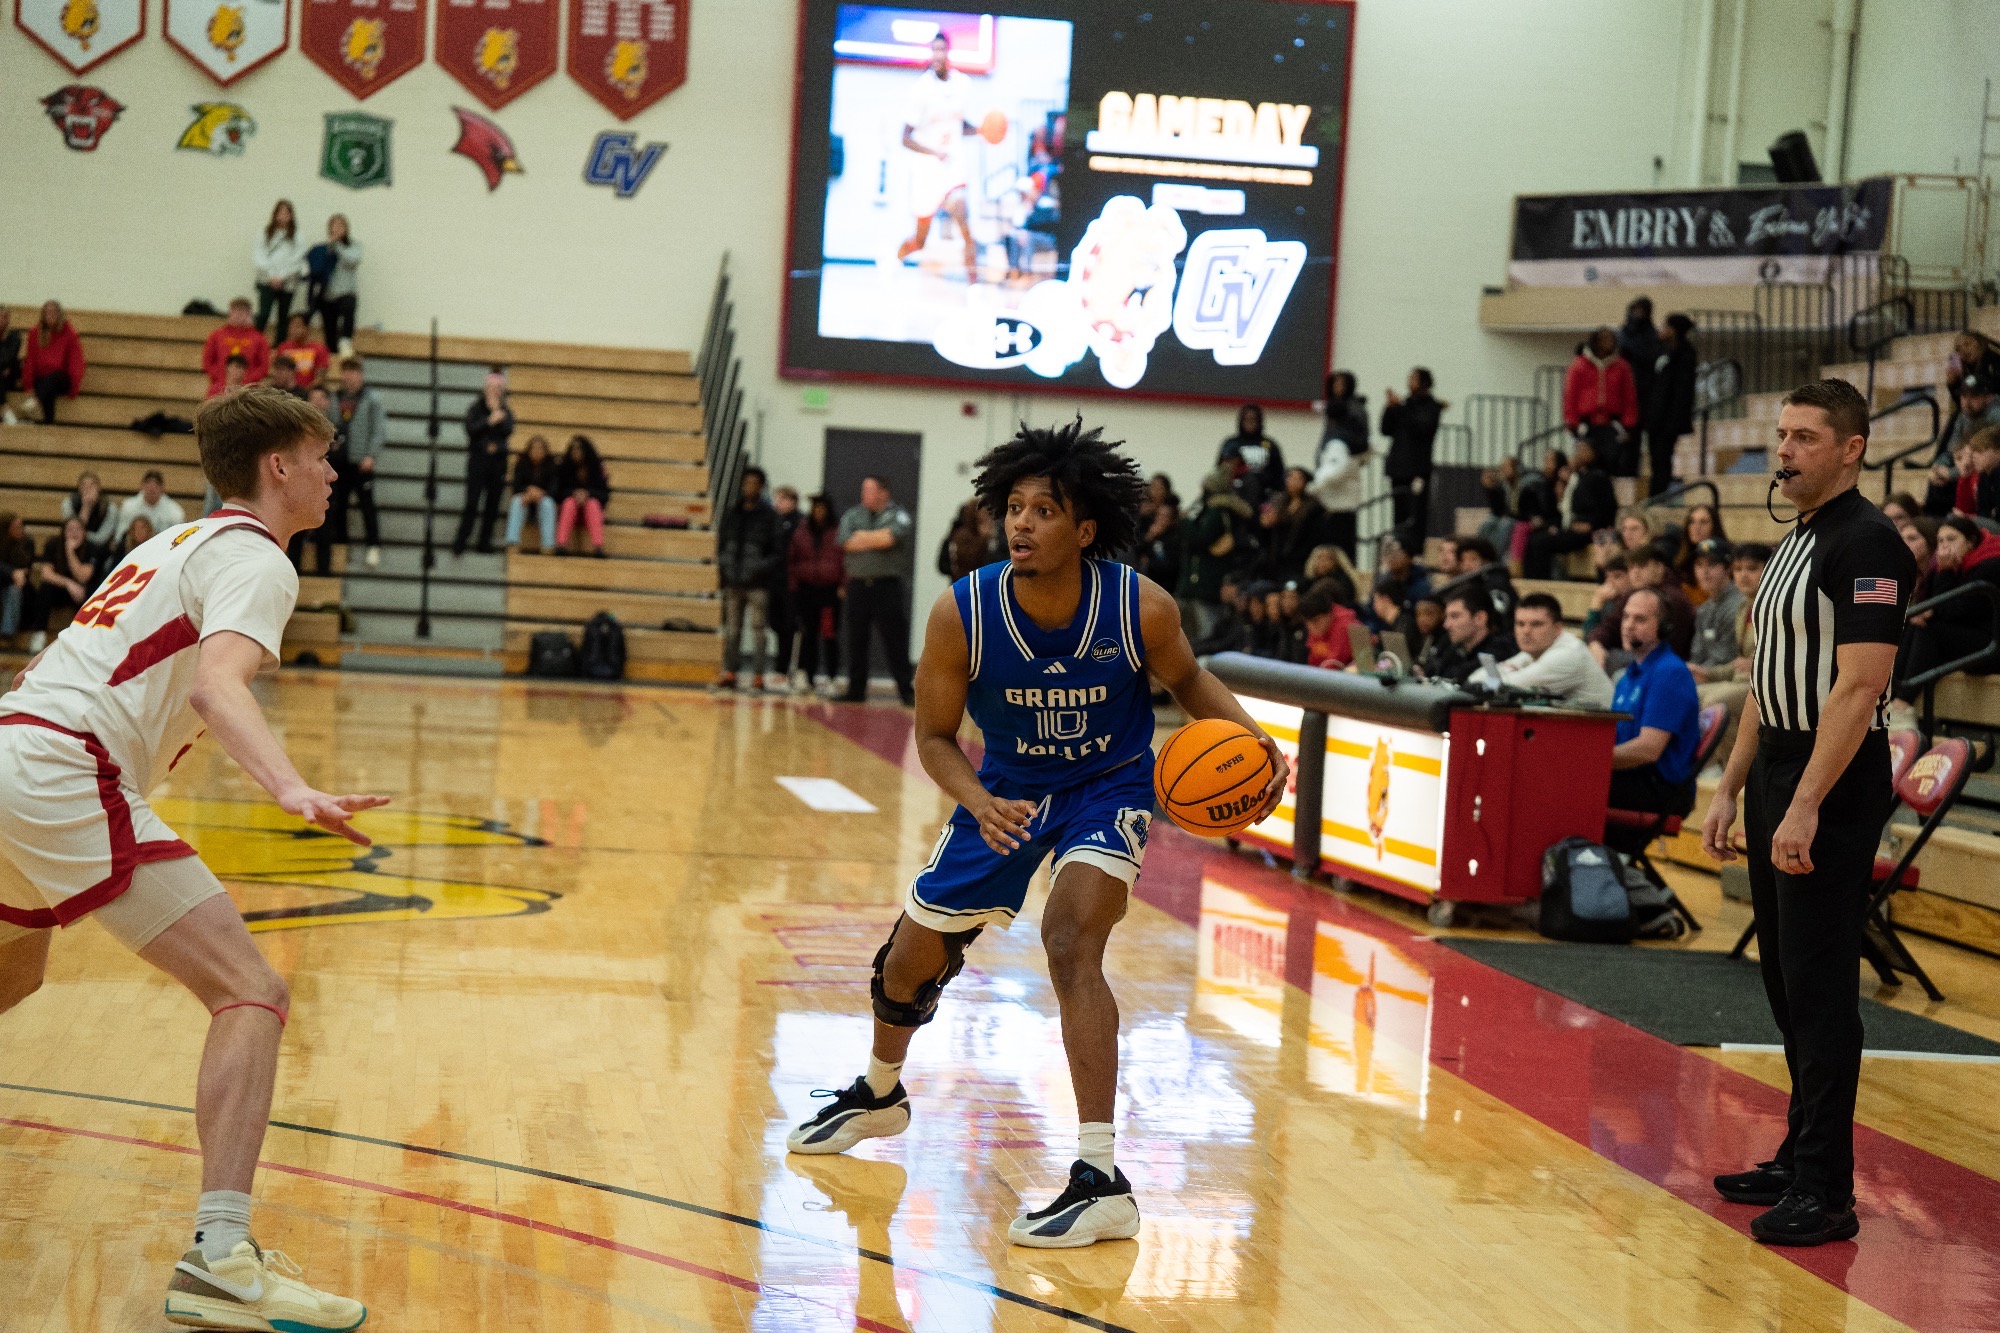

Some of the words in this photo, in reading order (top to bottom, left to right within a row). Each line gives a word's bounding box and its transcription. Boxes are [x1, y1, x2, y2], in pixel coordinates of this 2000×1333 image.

[1098, 91, 1312, 147] GAMEDAY
[583, 131, 669, 198] GV
[1572, 206, 1704, 248] EMBRY
[1177, 232, 1303, 362] GV
[73, 563, 158, 630] 22
[1005, 686, 1107, 708] GRAND
[1035, 710, 1088, 740] 10
[1206, 779, 1270, 822] Wilso
